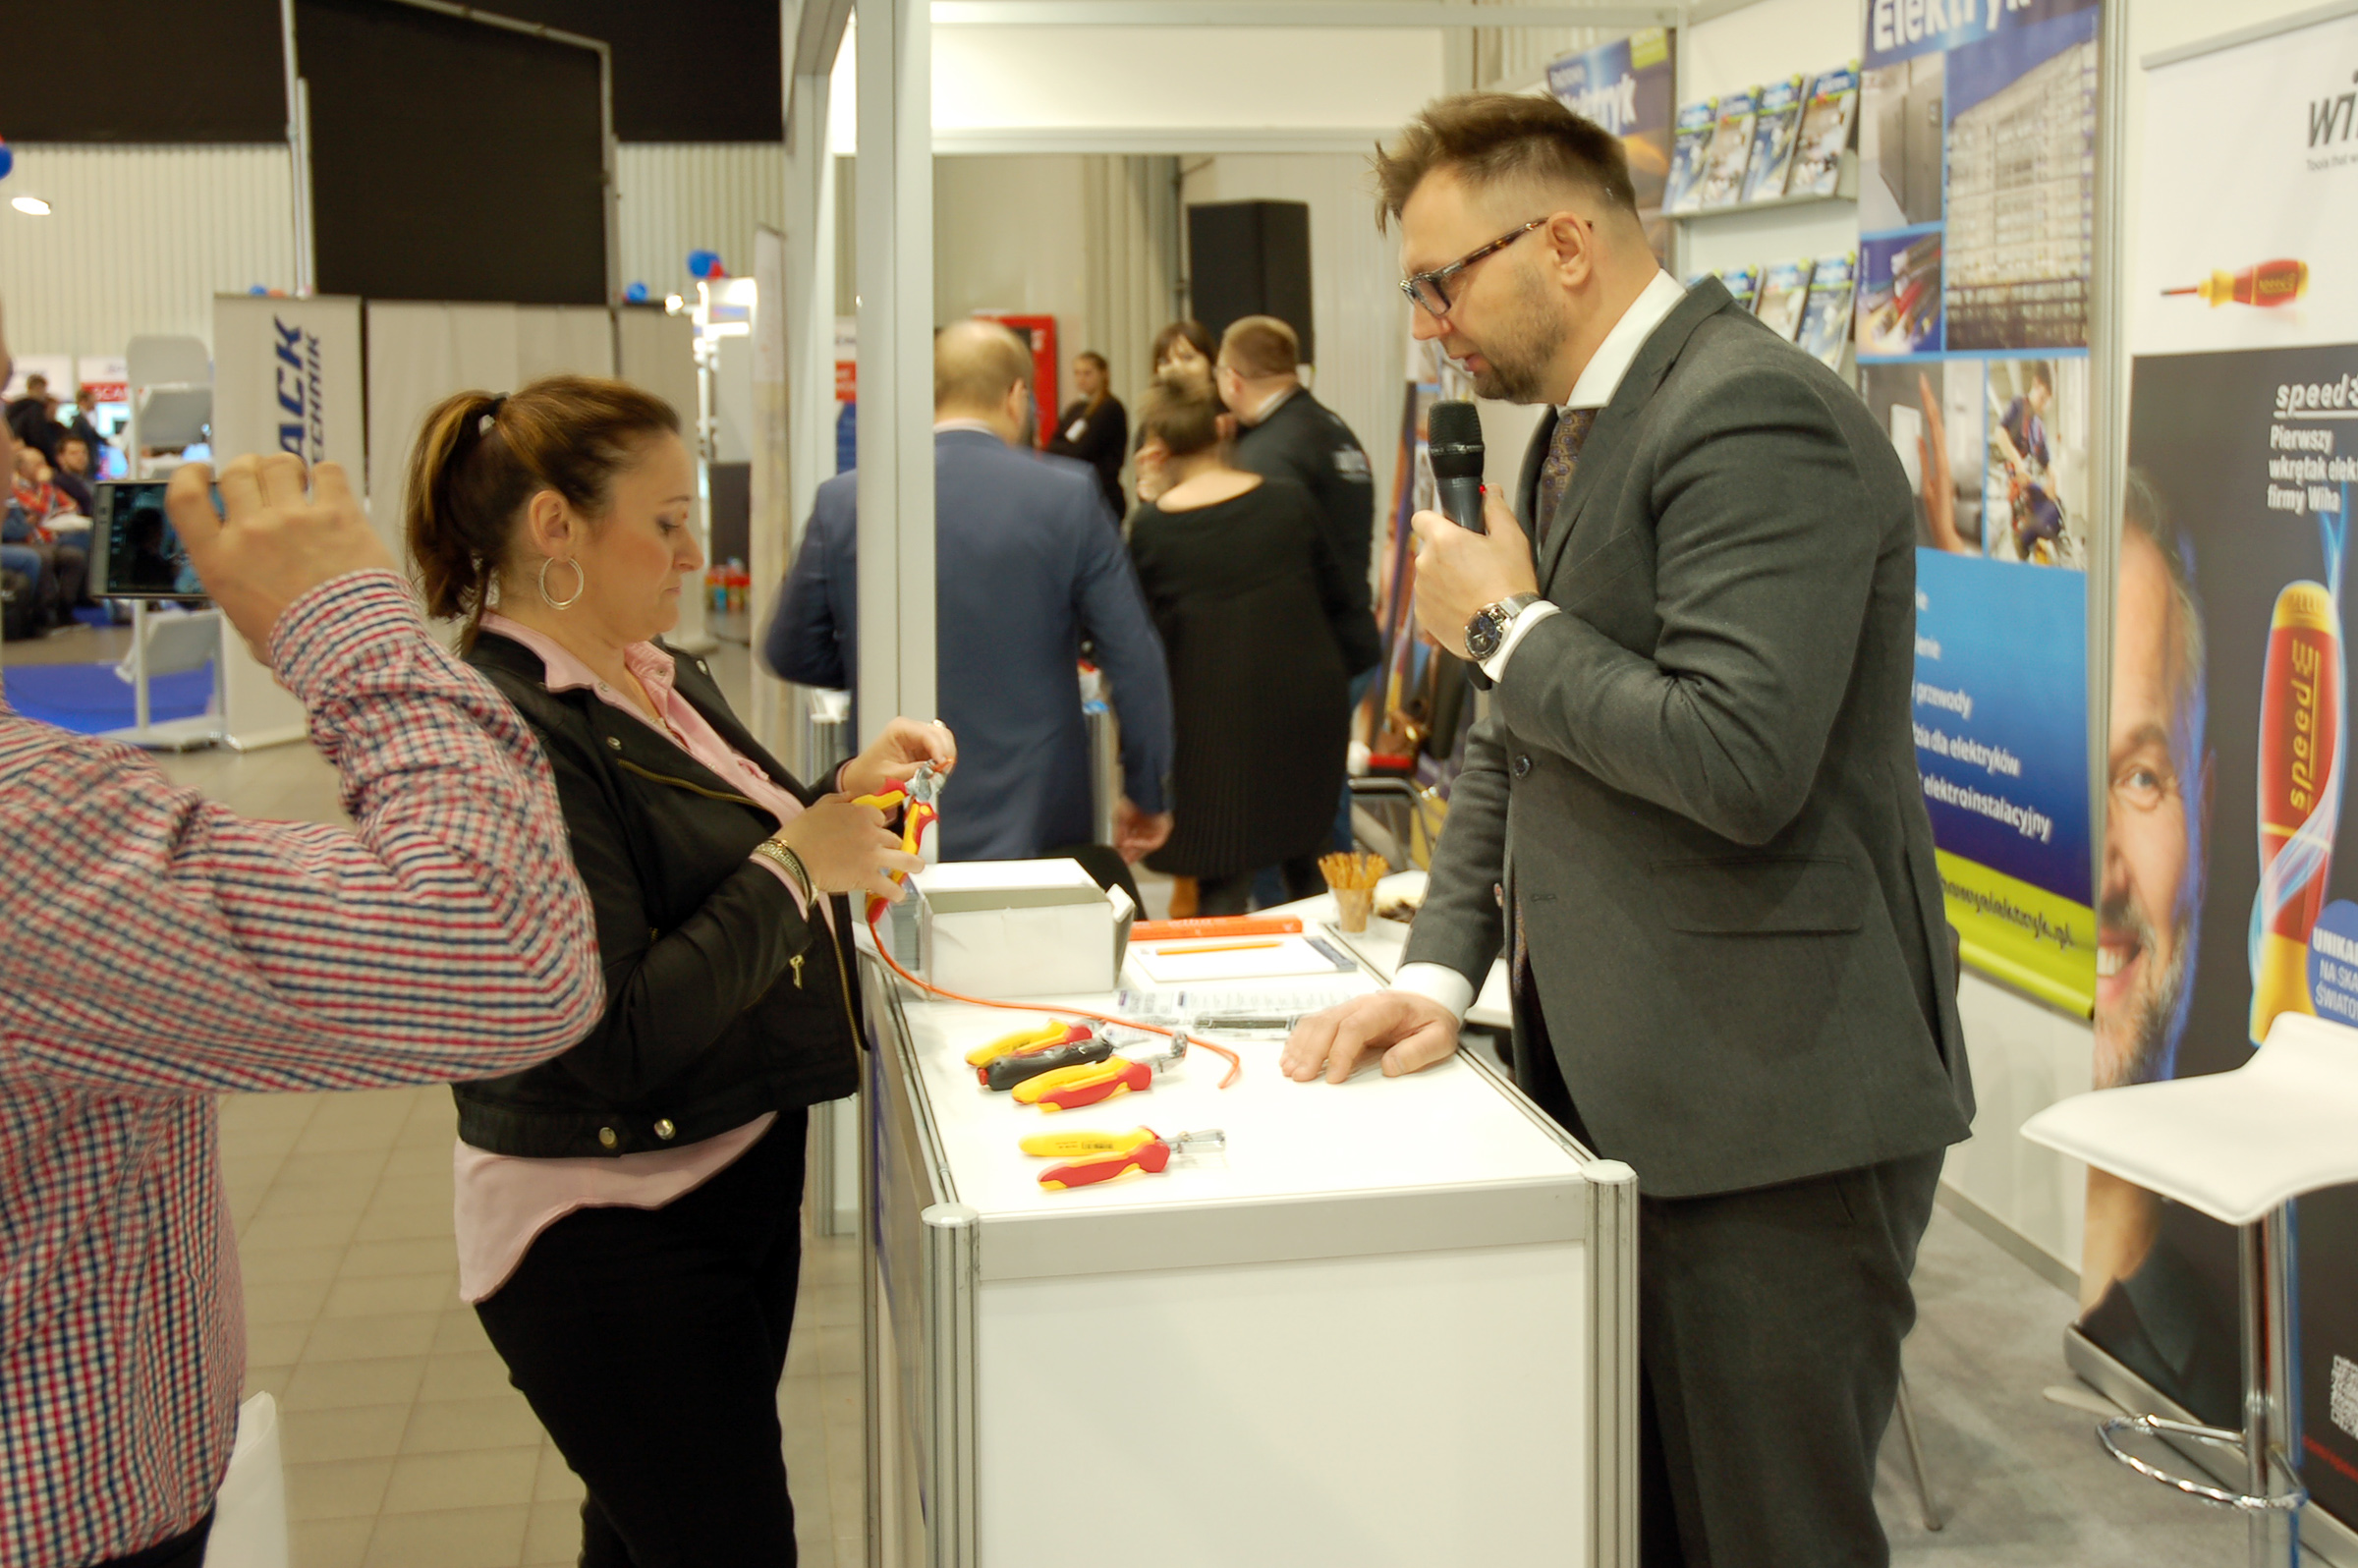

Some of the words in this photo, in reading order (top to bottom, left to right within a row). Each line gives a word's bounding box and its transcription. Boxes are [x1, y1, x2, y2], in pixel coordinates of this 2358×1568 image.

[1874, 0, 2031, 52] Elektry
[2308, 70, 2358, 147] wi
[273, 311, 307, 464] ACK
[2271, 424, 2333, 456] Pierwszy
[2269, 455, 2327, 486] wkrętak
[2329, 456, 2358, 481] elek
[2267, 483, 2306, 516] firmy
[2308, 485, 2340, 513] Wiha
[1931, 728, 1948, 756] dla
[1949, 735, 2022, 777] elektryków
[1924, 772, 2051, 845] elektroinstalacyjny
[2320, 958, 2337, 983] NA
[2315, 980, 2358, 1021] ŚWIATO
